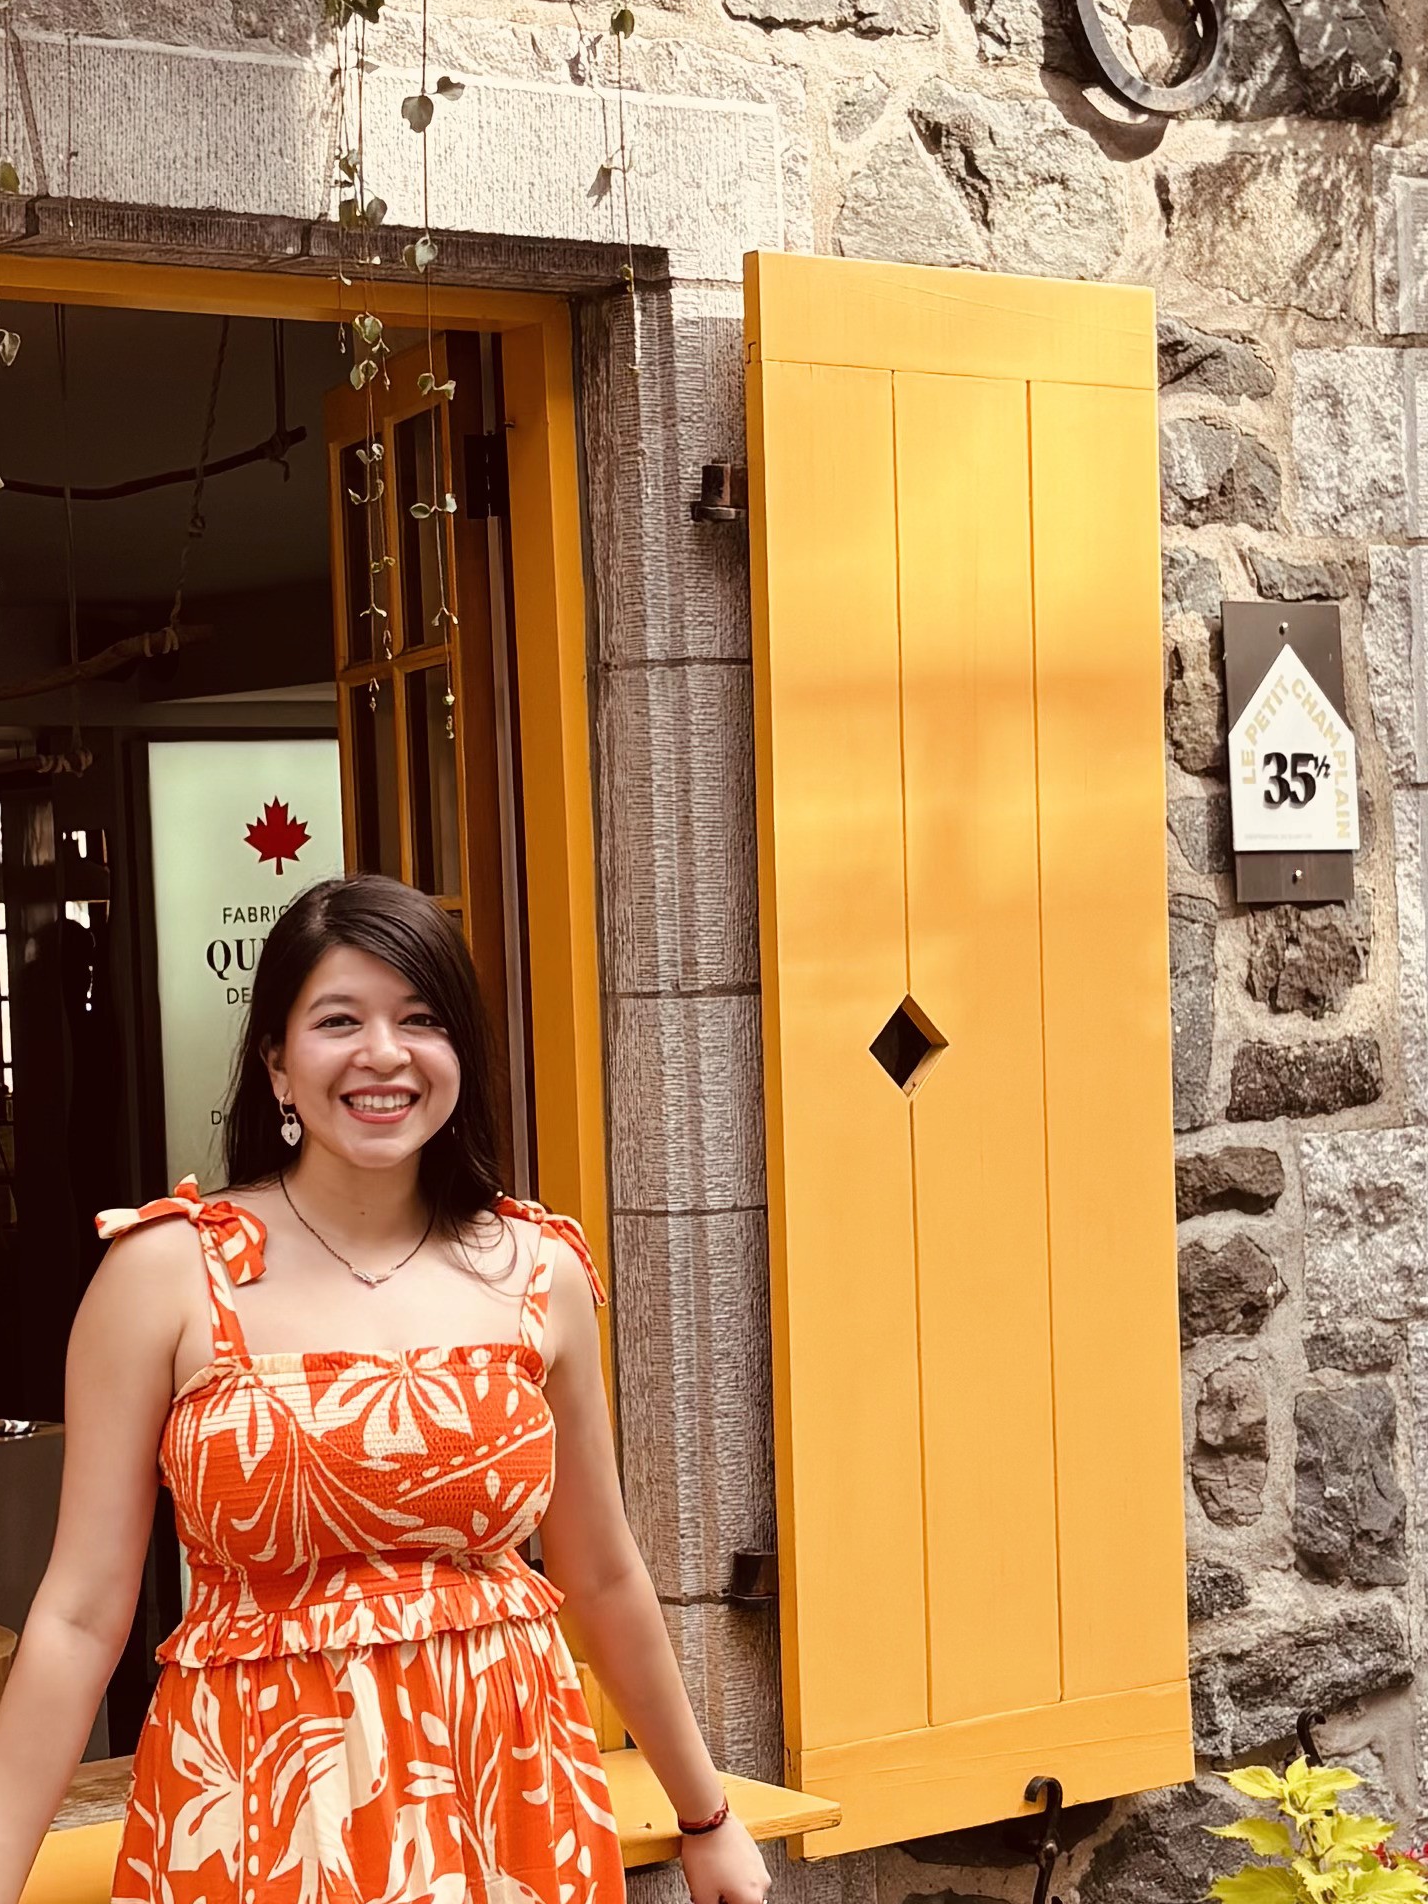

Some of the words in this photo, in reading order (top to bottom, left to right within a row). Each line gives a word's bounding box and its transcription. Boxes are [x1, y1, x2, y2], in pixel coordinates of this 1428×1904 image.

[1244, 674, 1291, 747] PETIT
[1241, 749, 1257, 785] LE
[1291, 677, 1351, 840] CHAMPLAIN
